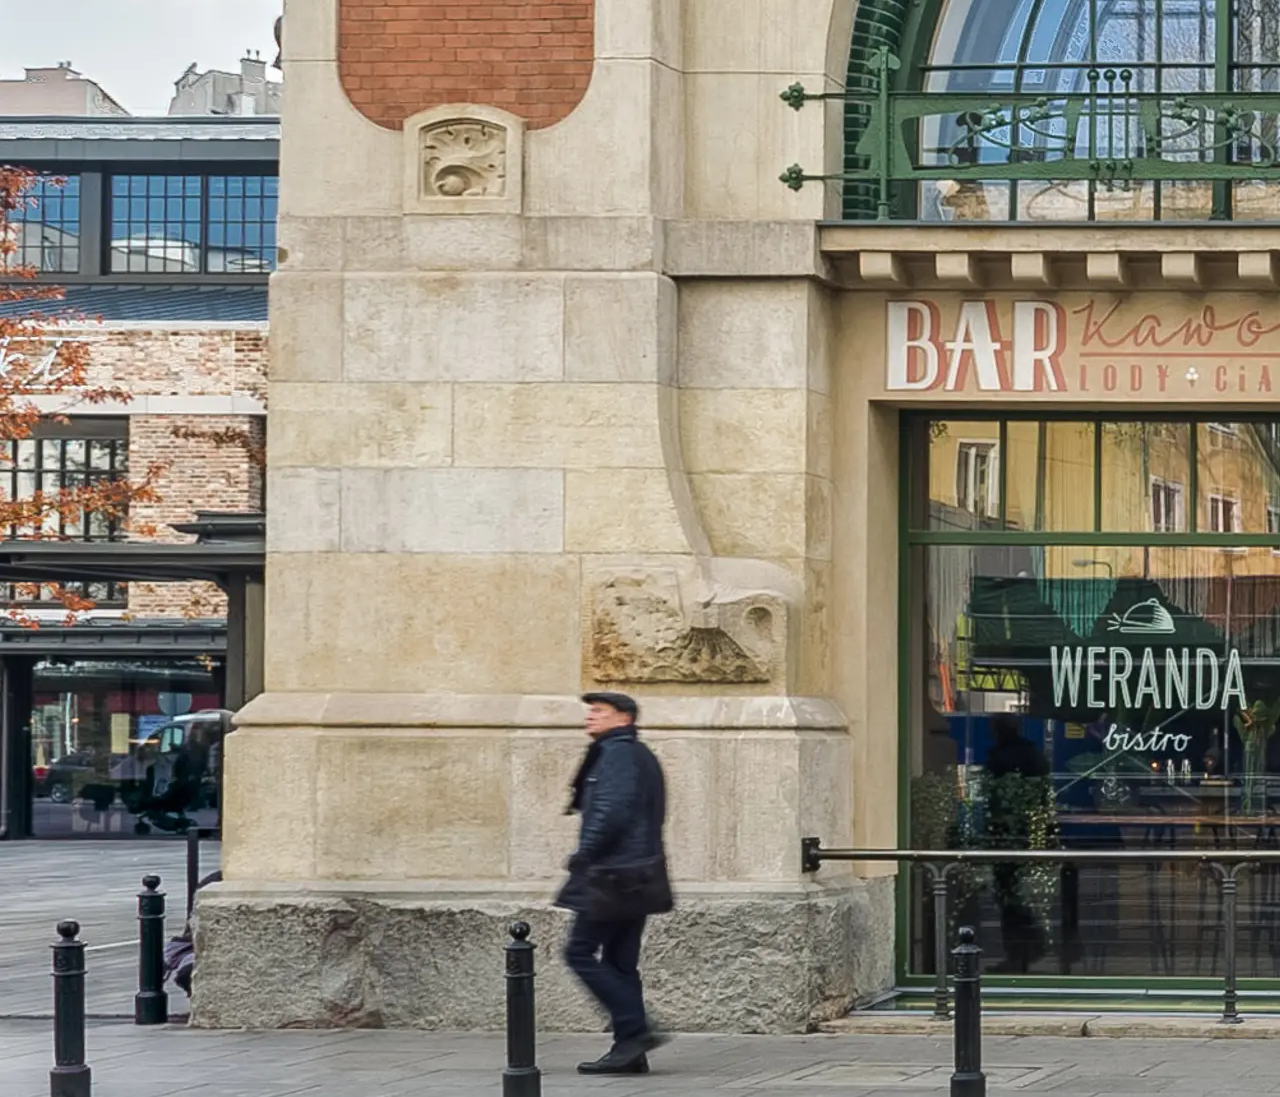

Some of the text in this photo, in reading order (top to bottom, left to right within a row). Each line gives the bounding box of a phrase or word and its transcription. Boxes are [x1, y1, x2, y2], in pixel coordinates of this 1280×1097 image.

[884, 299, 1067, 391] BAR
[1079, 364, 1170, 393] LODY
[1050, 645, 1248, 711] WERANDA
[1102, 723, 1193, 752] bistro
